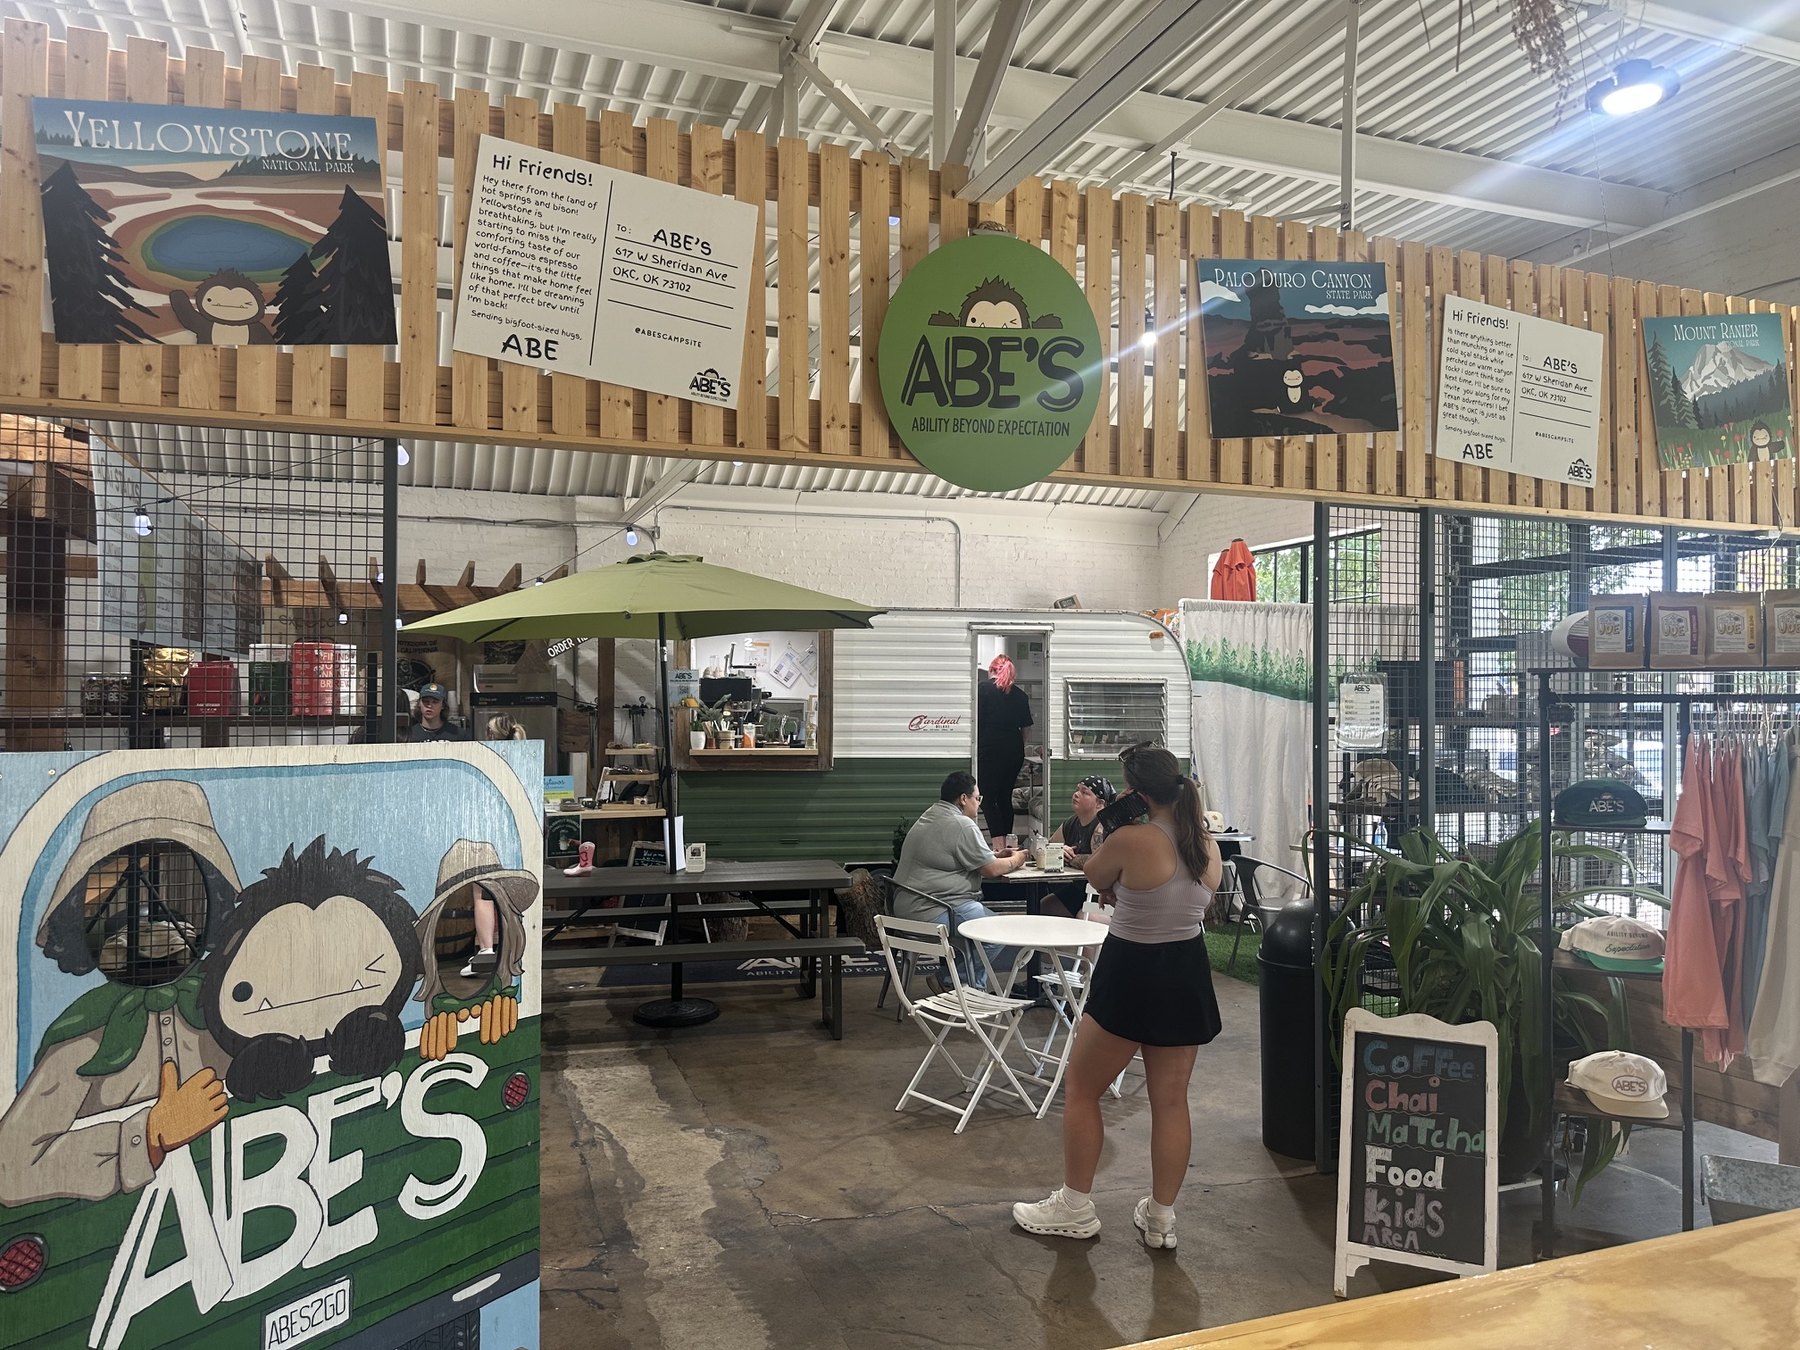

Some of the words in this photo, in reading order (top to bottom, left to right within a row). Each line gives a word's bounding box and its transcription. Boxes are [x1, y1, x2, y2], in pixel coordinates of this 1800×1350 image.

[64, 110, 354, 161] YELLOWSTONE
[262, 159, 321, 172] NATIONAL
[325, 162, 355, 173] PARK
[493, 154, 512, 170] Hi
[519, 159, 592, 186] Friends!
[482, 184, 496, 195] hot
[499, 191, 532, 205] springs
[535, 200, 551, 209] and
[552, 203, 578, 216] bison!
[483, 175, 499, 187] Hey
[501, 179, 524, 191] there
[526, 185, 548, 197] from
[550, 191, 564, 201] the
[567, 195, 586, 207] land
[587, 202, 598, 210] of
[480, 196, 532, 215] Yellowstone
[534, 209, 542, 218] is
[478, 219, 513, 235] starting
[516, 227, 525, 236] to
[528, 231, 549, 241] miss
[552, 236, 566, 246] the
[479, 207, 537, 229] breathtaking,
[540, 222, 554, 231] but
[557, 226, 570, 235] I'm
[573, 231, 597, 244] really
[476, 231, 525, 249] comforting
[528, 241, 551, 253] taste
[553, 248, 564, 257] of
[565, 252, 580, 260] our
[652, 229, 711, 256] ABE'S
[474, 252, 490, 261] and
[544, 267, 558, 277] the
[560, 271, 581, 282] little
[475, 242, 536, 260] world-famous
[539, 256, 578, 270] espresso
[615, 247, 634, 258] 617
[637, 252, 648, 261] W
[651, 254, 702, 274] Sheridan
[706, 269, 727, 281] Ave
[470, 272, 486, 283] like
[488, 276, 515, 289] home.
[518, 283, 529, 292] I'll
[531, 286, 542, 295] be
[544, 290, 584, 307] dreaming
[472, 261, 499, 275] things
[502, 268, 521, 279] that
[523, 274, 547, 285] make
[549, 278, 573, 291] home
[575, 285, 592, 295] feel
[613, 266, 639, 281] OKC,
[643, 273, 659, 286] OK
[663, 279, 691, 292] 73102
[1214, 268, 1256, 288] PALO
[1261, 269, 1306, 288] DURO
[1311, 269, 1372, 289] CANYON
[467, 294, 484, 304] I'm
[484, 298, 508, 310] back!
[468, 284, 480, 293] of
[482, 286, 500, 296] that
[503, 293, 535, 304] perfect
[537, 299, 558, 310] brew
[560, 305, 580, 314] until
[1326, 290, 1351, 300] STATE
[1353, 291, 1373, 300] PARK
[471, 310, 503, 324] Sending
[505, 317, 559, 335] bigfoot-sized
[561, 329, 582, 340] hugs,
[1453, 310, 1463, 322] Hi
[1467, 312, 1508, 329] Friends!
[1673, 324, 1717, 341] MOUNT
[1720, 322, 1759, 339] RANIER
[501, 334, 559, 361] ABE
[635, 327, 701, 348] @ABESCAMPSITE
[901, 334, 1085, 413] ABE'S
[1543, 356, 1577, 374] ABE'S
[689, 376, 731, 397] ABE'S
[1521, 386, 1537, 397] OKC,
[1538, 390, 1548, 399] OK
[1550, 394, 1566, 403] 73102
[1522, 372, 1533, 380] 617
[1543, 376, 1573, 388] Sheridan
[1574, 383, 1587, 392] Ave
[911, 416, 950, 432] ABILITY
[953, 417, 995, 434] BEYOND
[997, 419, 1070, 437] EXPECTATION
[1463, 443, 1493, 459] ABE
[1567, 465, 1592, 480] ABE'S
[1599, 624, 1620, 635] JOE
[1719, 623, 1741, 635] JOE
[547, 637, 575, 657] ORDER
[908, 714, 961, 731] Cardinal
[1589, 800, 1624, 812] ABE'S
[1364, 1077, 1441, 1112] Chai
[1616, 1080, 1646, 1092] ABE'S
[1365, 1144, 1445, 1189] Food
[87, 1052, 490, 1350] ABE'S
[268, 1289, 346, 1349] ABES2GO
